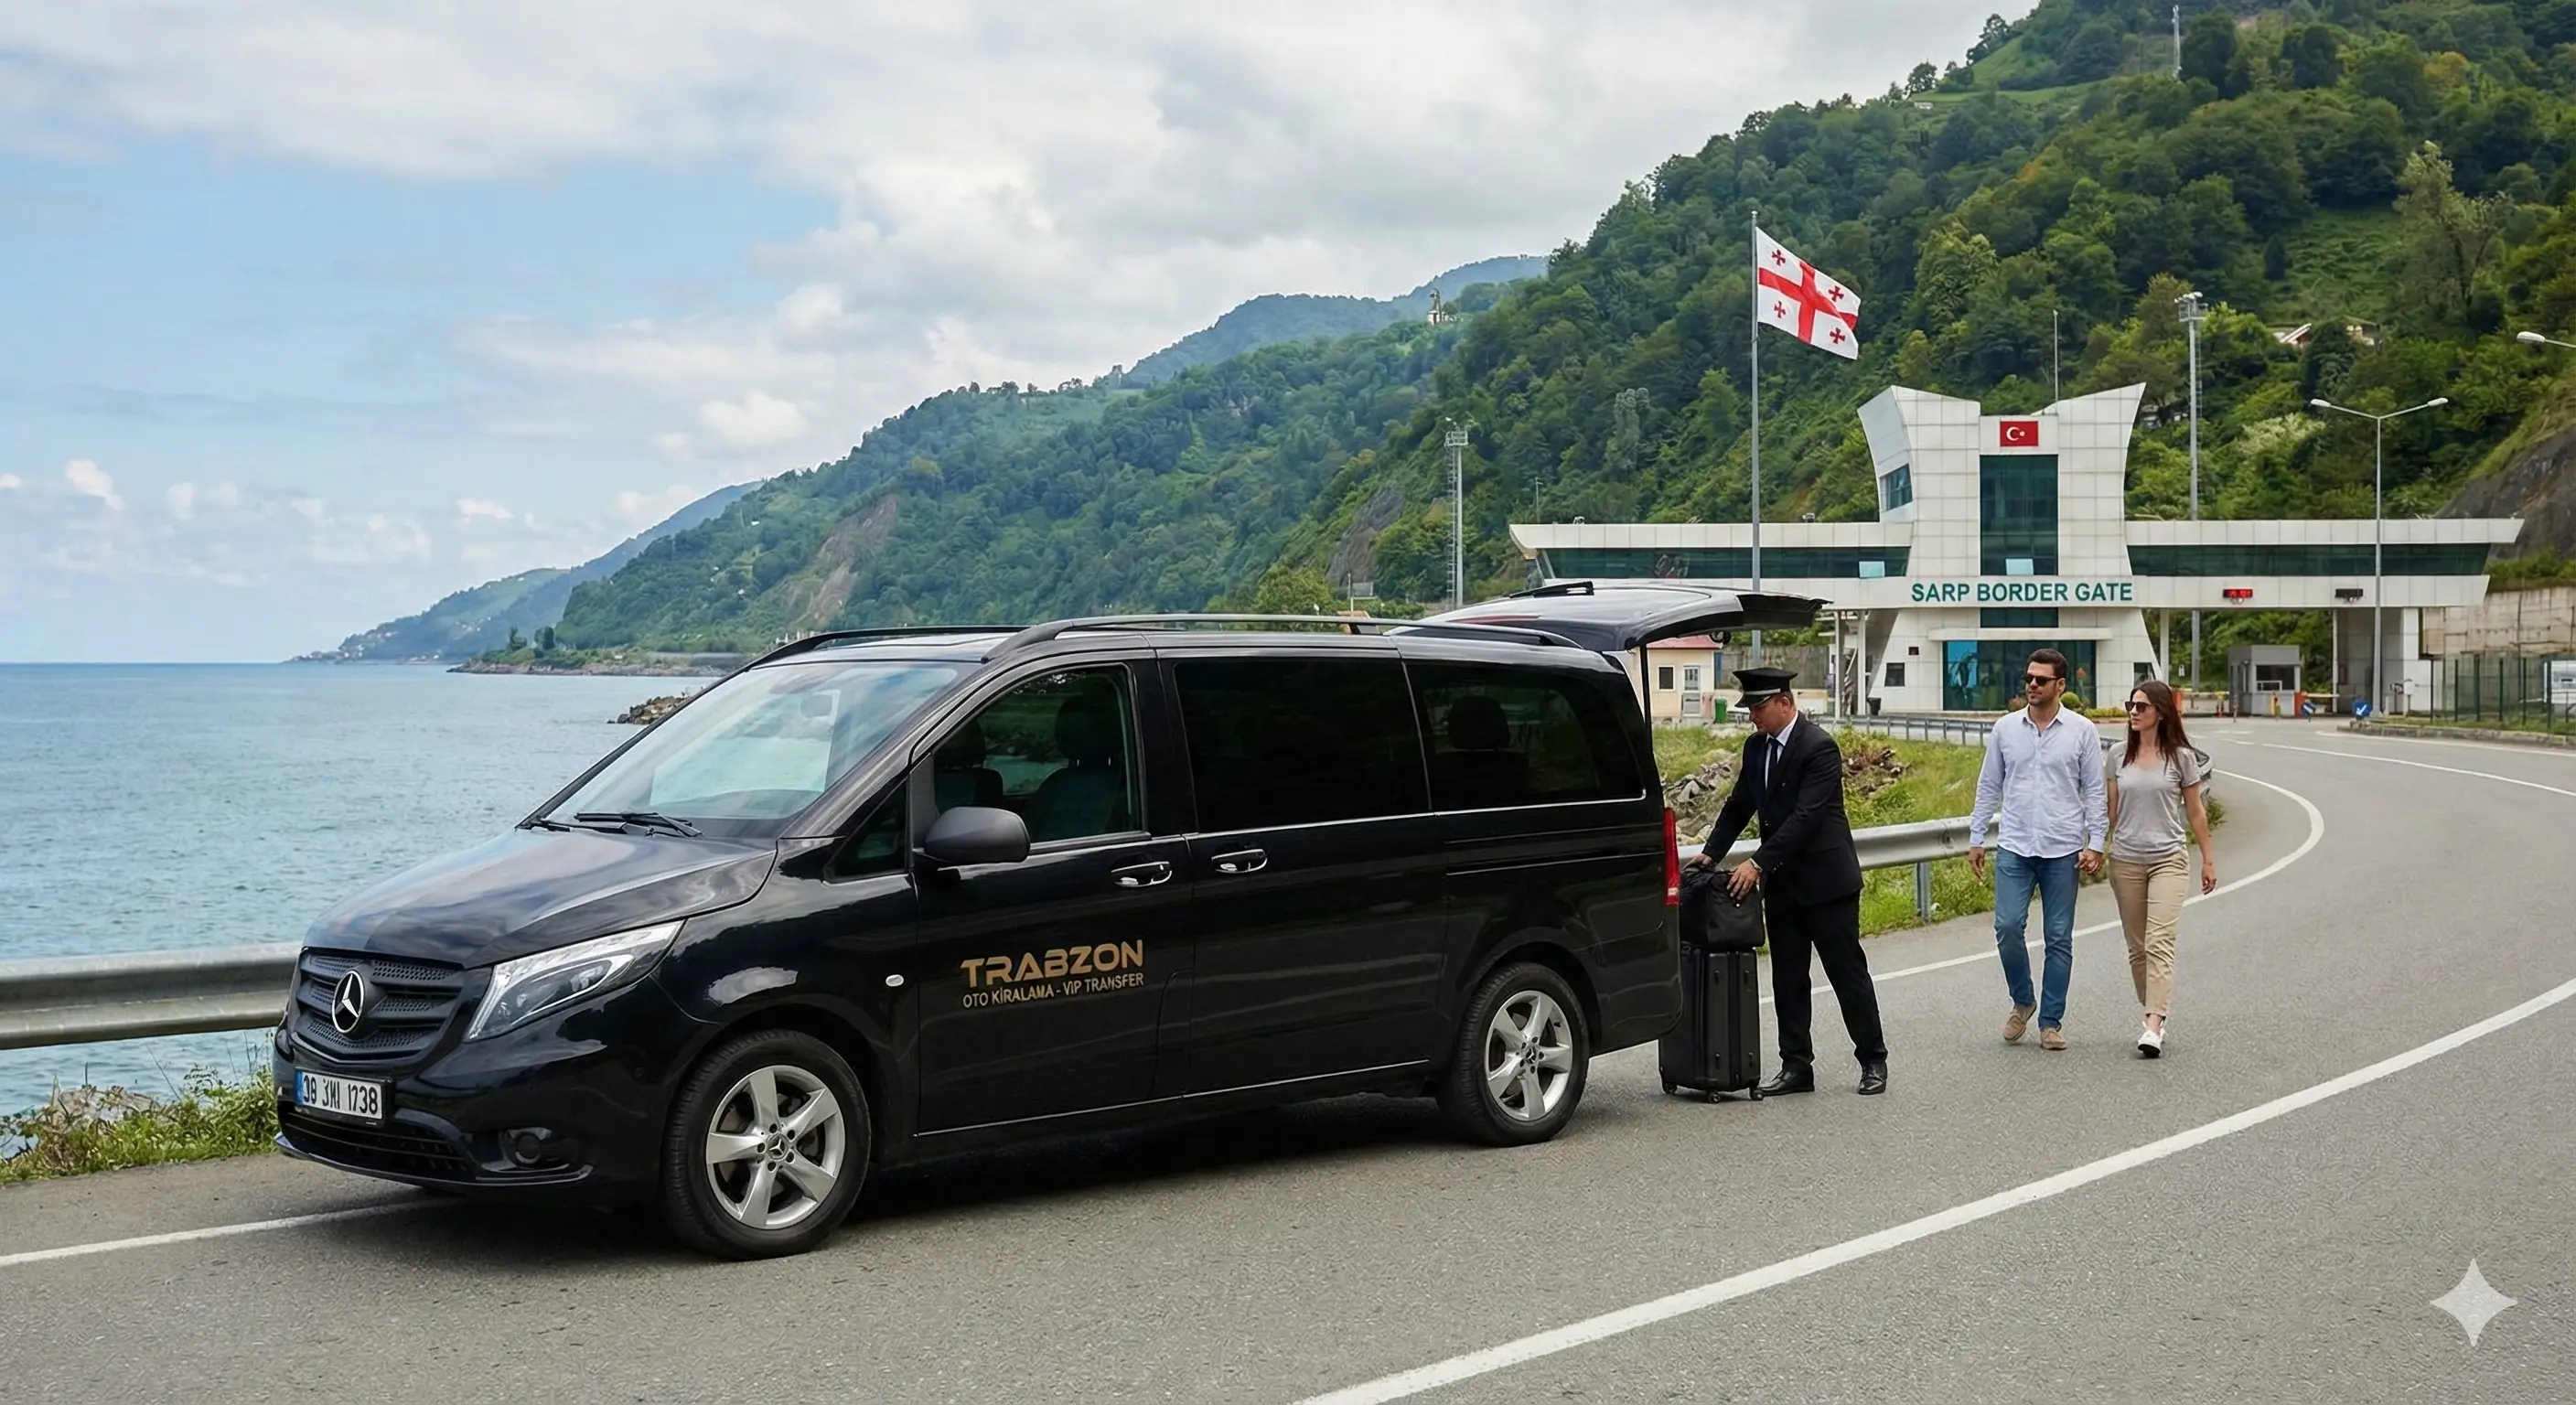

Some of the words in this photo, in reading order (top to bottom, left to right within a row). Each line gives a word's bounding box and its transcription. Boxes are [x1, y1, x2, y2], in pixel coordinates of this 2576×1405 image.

[1911, 583, 1970, 602] SARP
[1977, 583, 2068, 602] BORDER
[2075, 583, 2133, 602] GATE
[960, 939, 1143, 988] TRABZON
[962, 992, 989, 1008] OTO
[1062, 980, 1082, 995] VIP
[1084, 972, 1144, 993] TRANSFER
[348, 1083, 378, 1115] 1738
